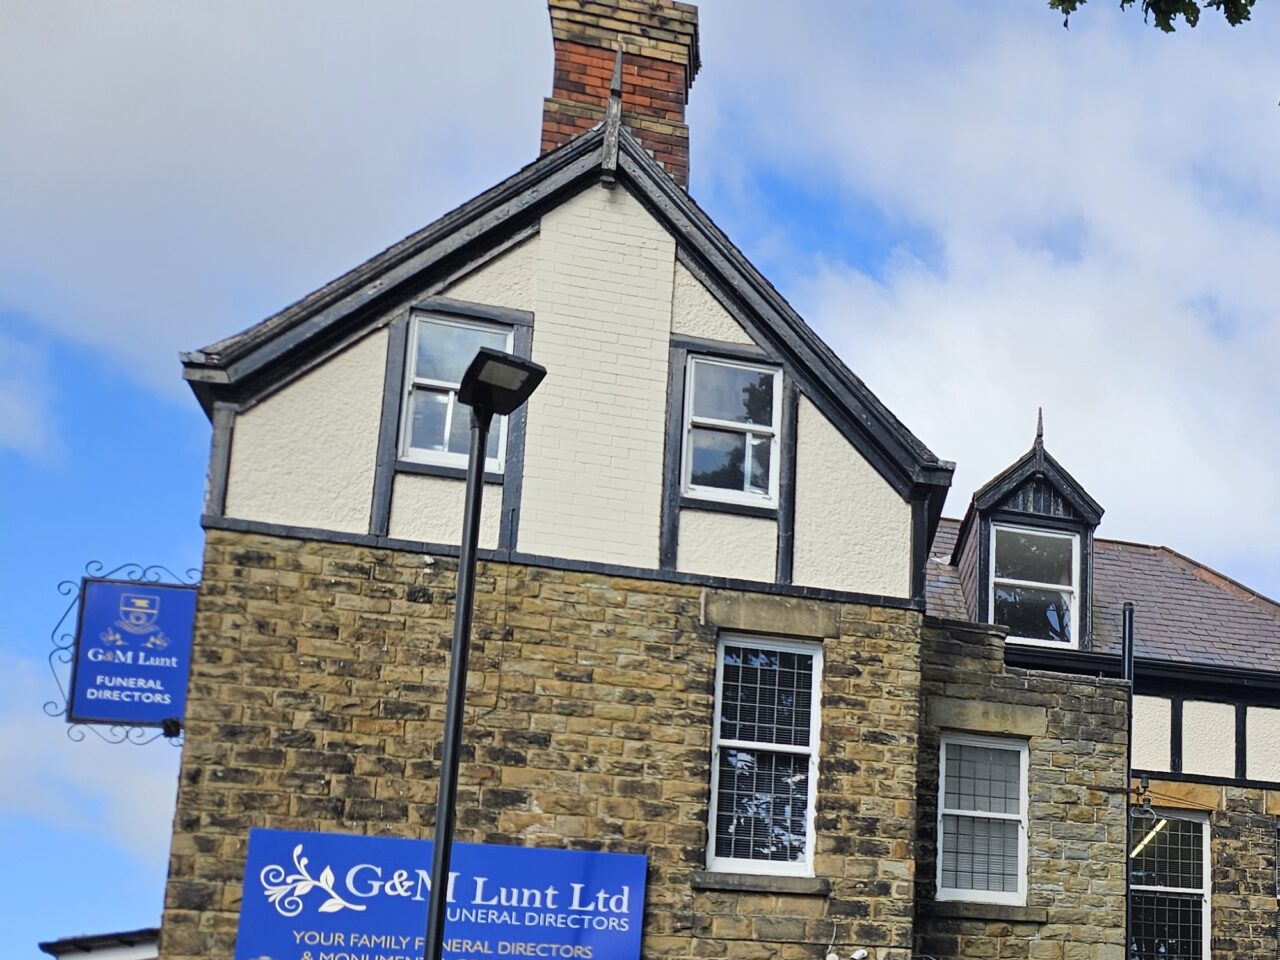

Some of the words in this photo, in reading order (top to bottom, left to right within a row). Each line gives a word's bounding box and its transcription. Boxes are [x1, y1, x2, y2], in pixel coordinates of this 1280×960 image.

[87, 648, 133, 664] G&M
[138, 652, 178, 667] Lunt
[96, 675, 164, 690] FUNERAL
[86, 689, 171, 704] DIRECTORS
[471, 877, 559, 909] Lunt
[568, 883, 630, 913] Ltd
[446, 908, 520, 925] UNERAL
[525, 912, 630, 931] DIRECTORS
[293, 930, 344, 946] YOUR
[350, 934, 410, 950] FAMILY
[415, 935, 493, 954] FNERAL
[498, 941, 593, 959] DIRECTORS
